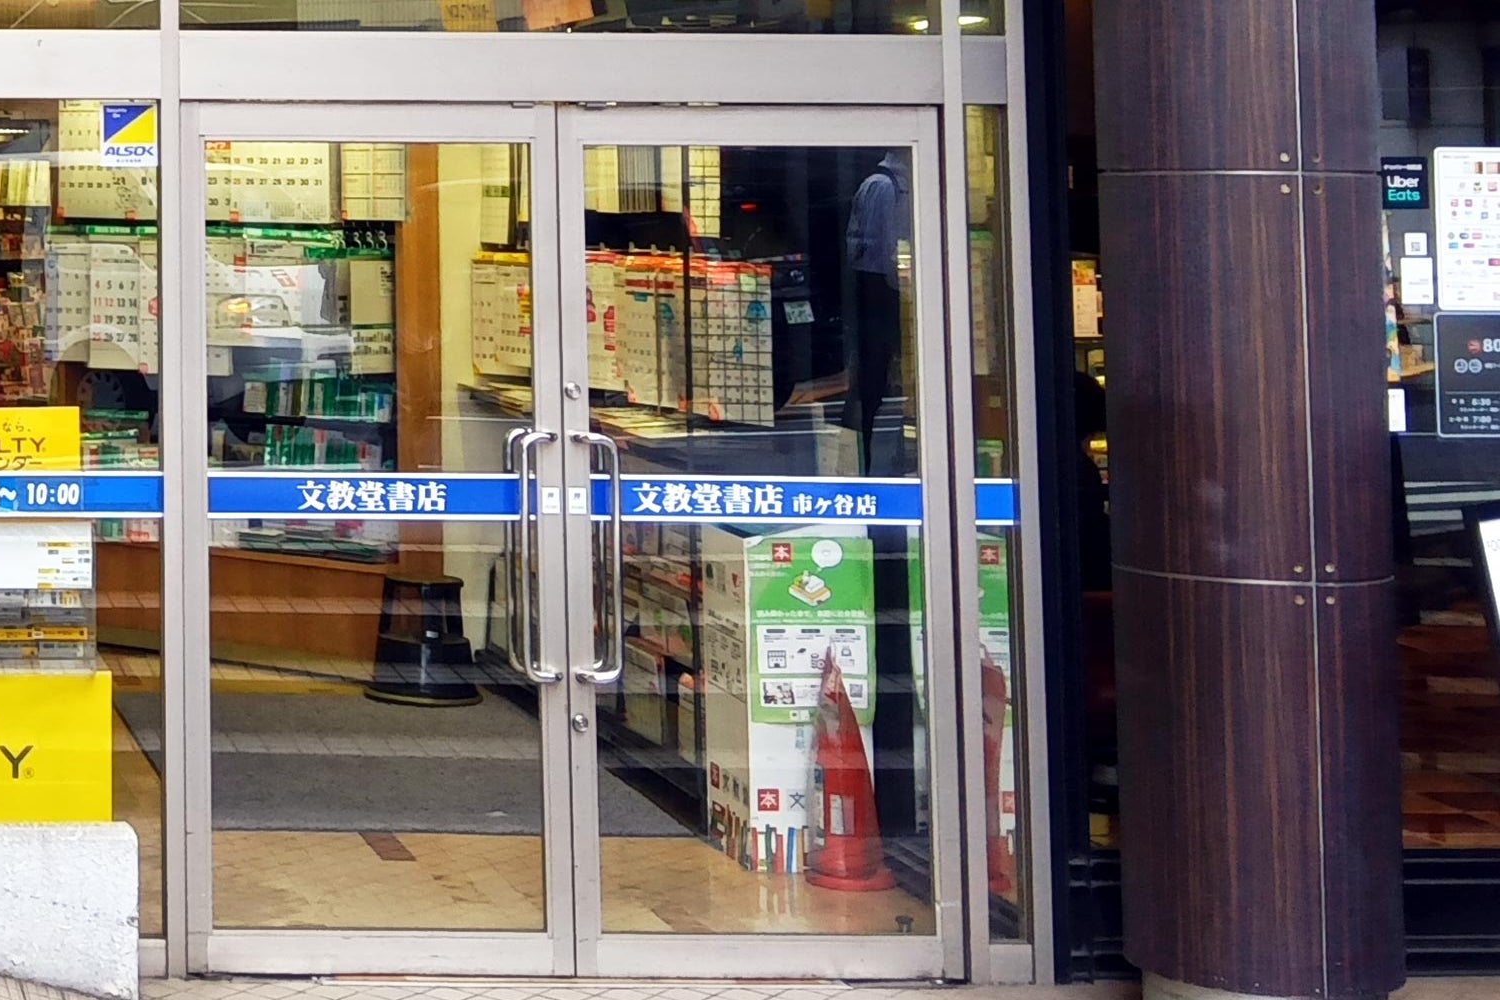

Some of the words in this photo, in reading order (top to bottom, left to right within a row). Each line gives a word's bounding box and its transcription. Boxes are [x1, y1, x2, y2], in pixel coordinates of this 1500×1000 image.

[104, 146, 154, 157] ALSOK
[1386, 175, 1419, 188] Uber
[1388, 189, 1420, 201] Eats
[27, 482, 80, 507] 10:00
[296, 480, 448, 512] 文教堂書店
[632, 482, 785, 515] 文教堂書店
